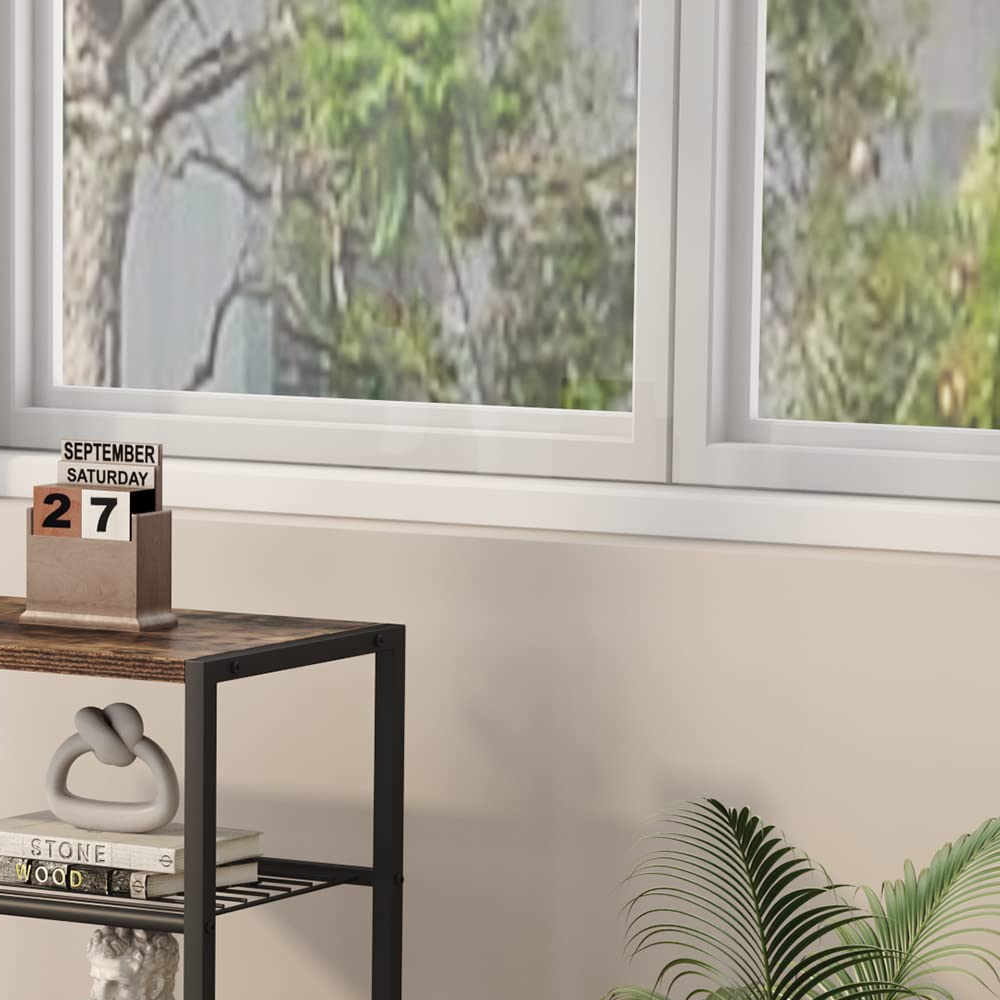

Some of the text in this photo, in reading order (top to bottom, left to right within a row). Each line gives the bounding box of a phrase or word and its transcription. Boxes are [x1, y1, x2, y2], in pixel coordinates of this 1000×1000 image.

[63, 441, 156, 464] SEPTEMBER
[66, 467, 149, 487] SATURDAY
[30, 838, 107, 863] STONE
[14, 863, 83, 888] WOOD
